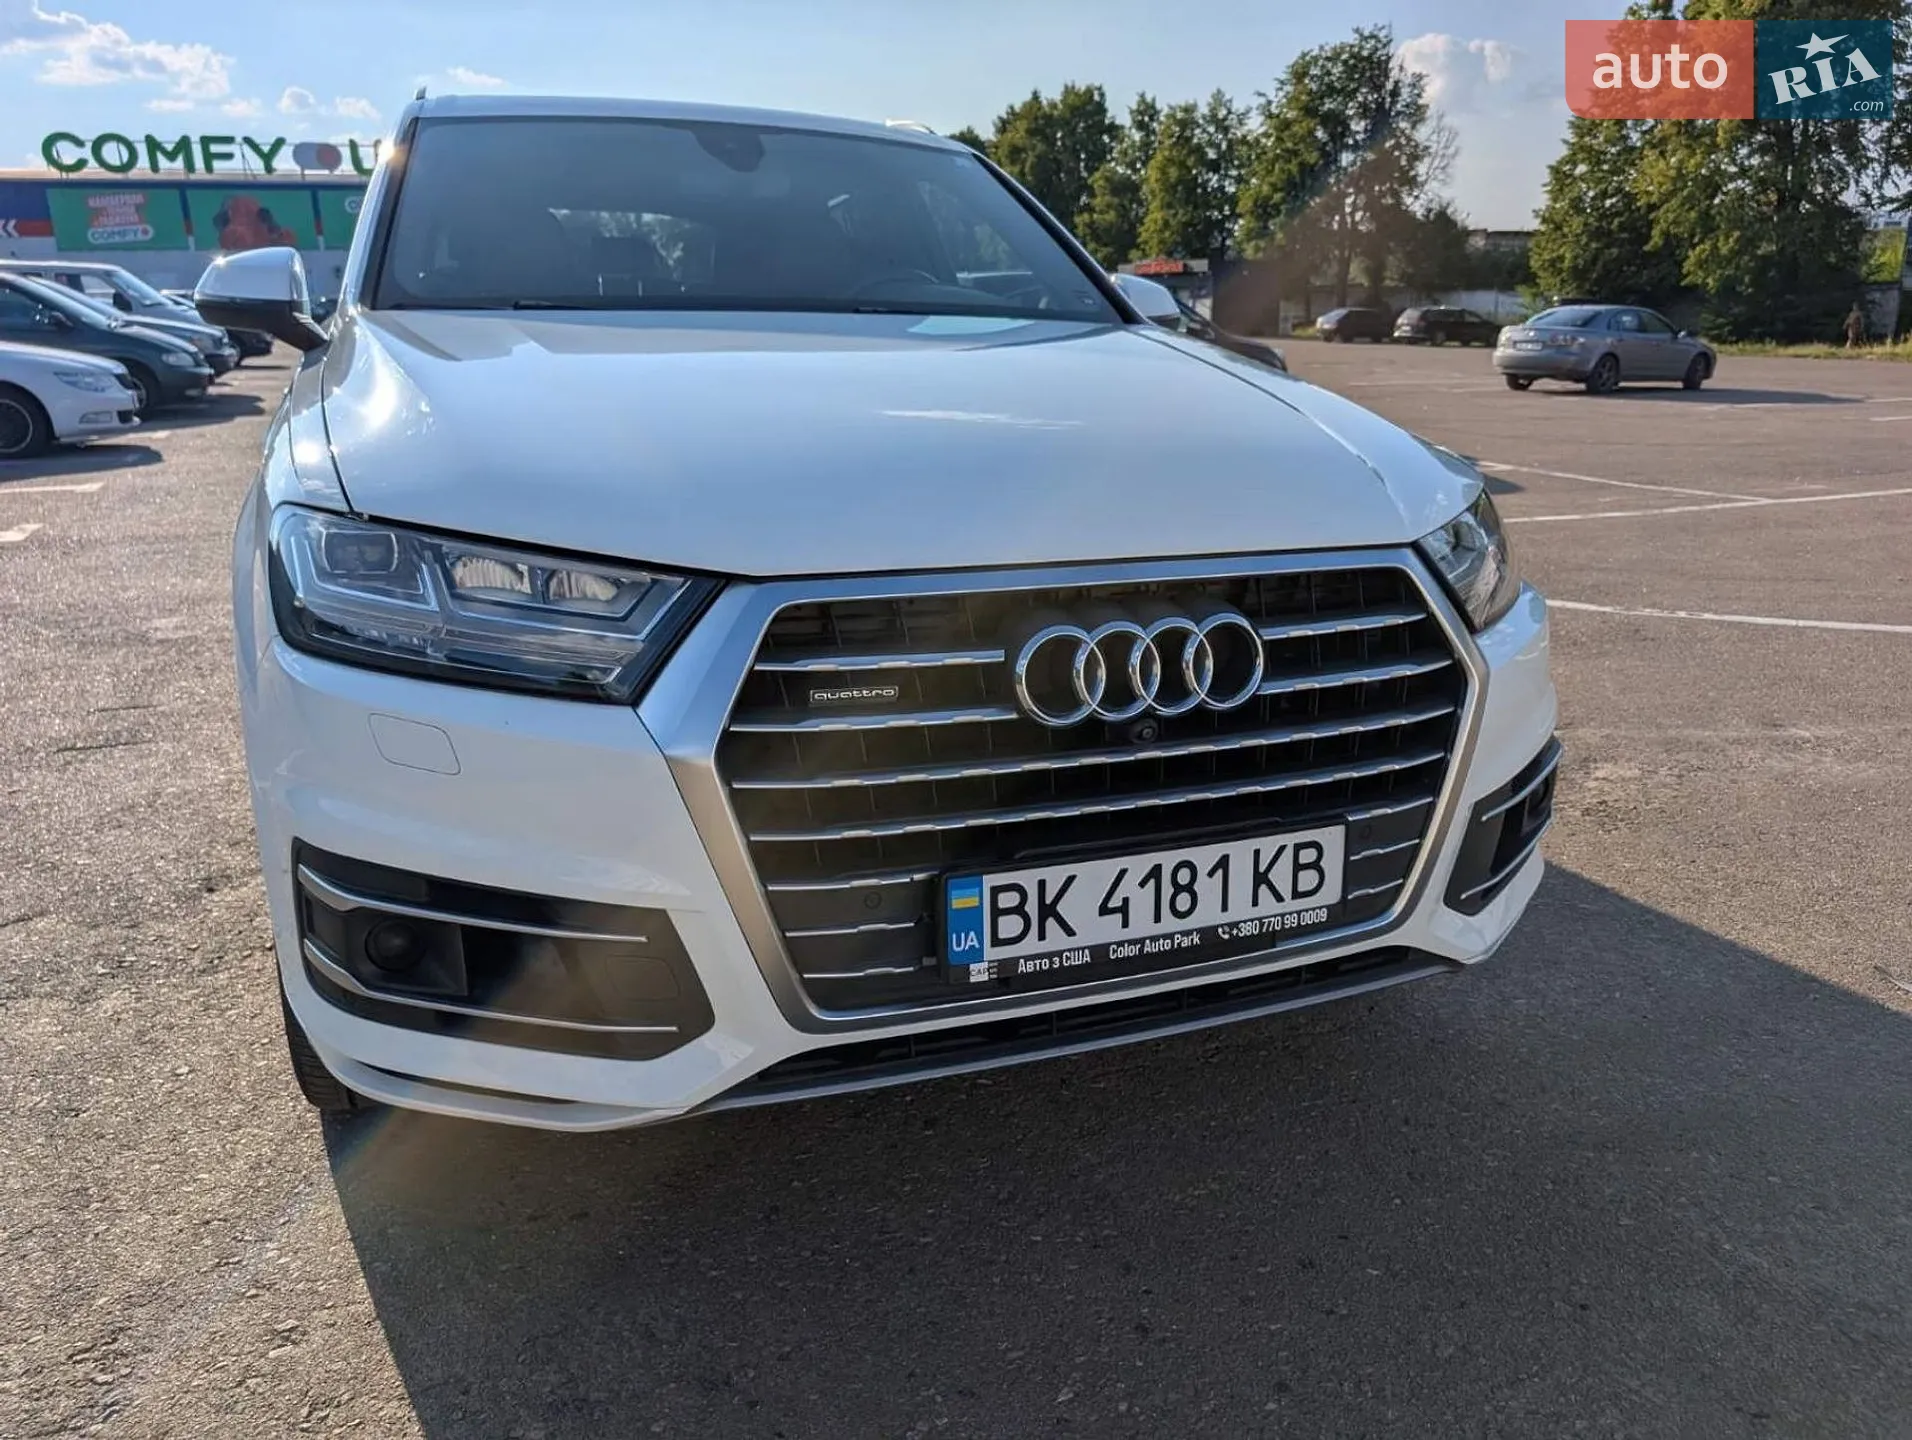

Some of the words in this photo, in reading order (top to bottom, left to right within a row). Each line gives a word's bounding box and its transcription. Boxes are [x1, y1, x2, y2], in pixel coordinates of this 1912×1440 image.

[41, 131, 286, 175] COMFY
[91, 228, 140, 243] COMFY
[814, 689, 895, 701] quattro
[989, 873, 1078, 949] BK
[1097, 852, 1231, 929] 4181
[1251, 840, 1326, 908] KB
[1231, 920, 1260, 938] +380
[1261, 915, 1282, 933] 770
[1284, 912, 1299, 929] 99
[1300, 907, 1328, 926] 0009
[952, 930, 980, 952] UA
[1109, 942, 1141, 960] Color
[1143, 937, 1172, 954] Auto
[1174, 931, 1200, 949] Park
[1018, 957, 1050, 974] Авто
[1062, 949, 1091, 968] США
